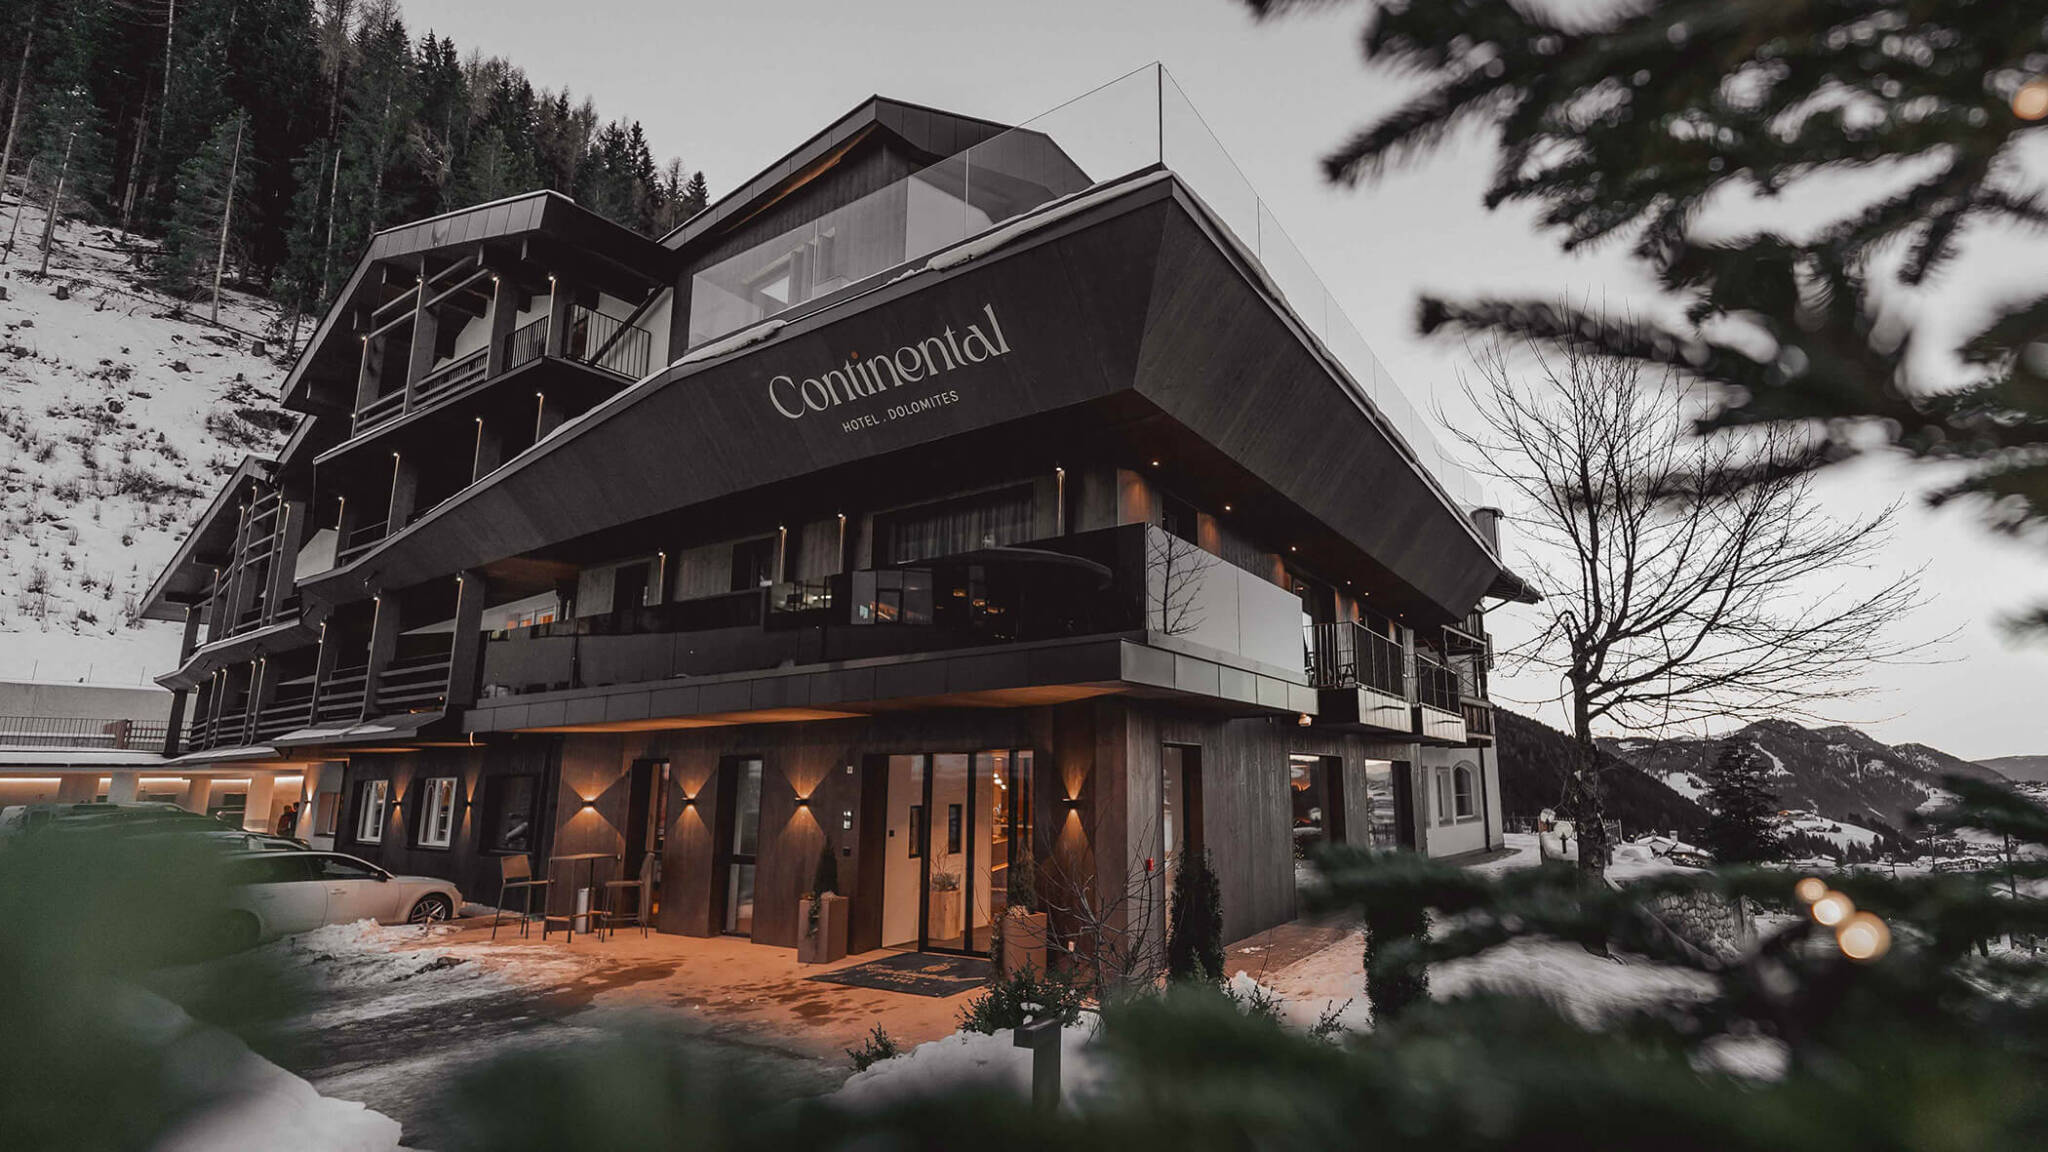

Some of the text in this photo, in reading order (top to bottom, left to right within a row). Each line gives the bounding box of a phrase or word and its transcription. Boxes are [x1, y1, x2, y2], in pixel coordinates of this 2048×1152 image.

[769, 303, 1011, 419] Continental
[842, 390, 959, 433] HOTEL DOLOMITES
